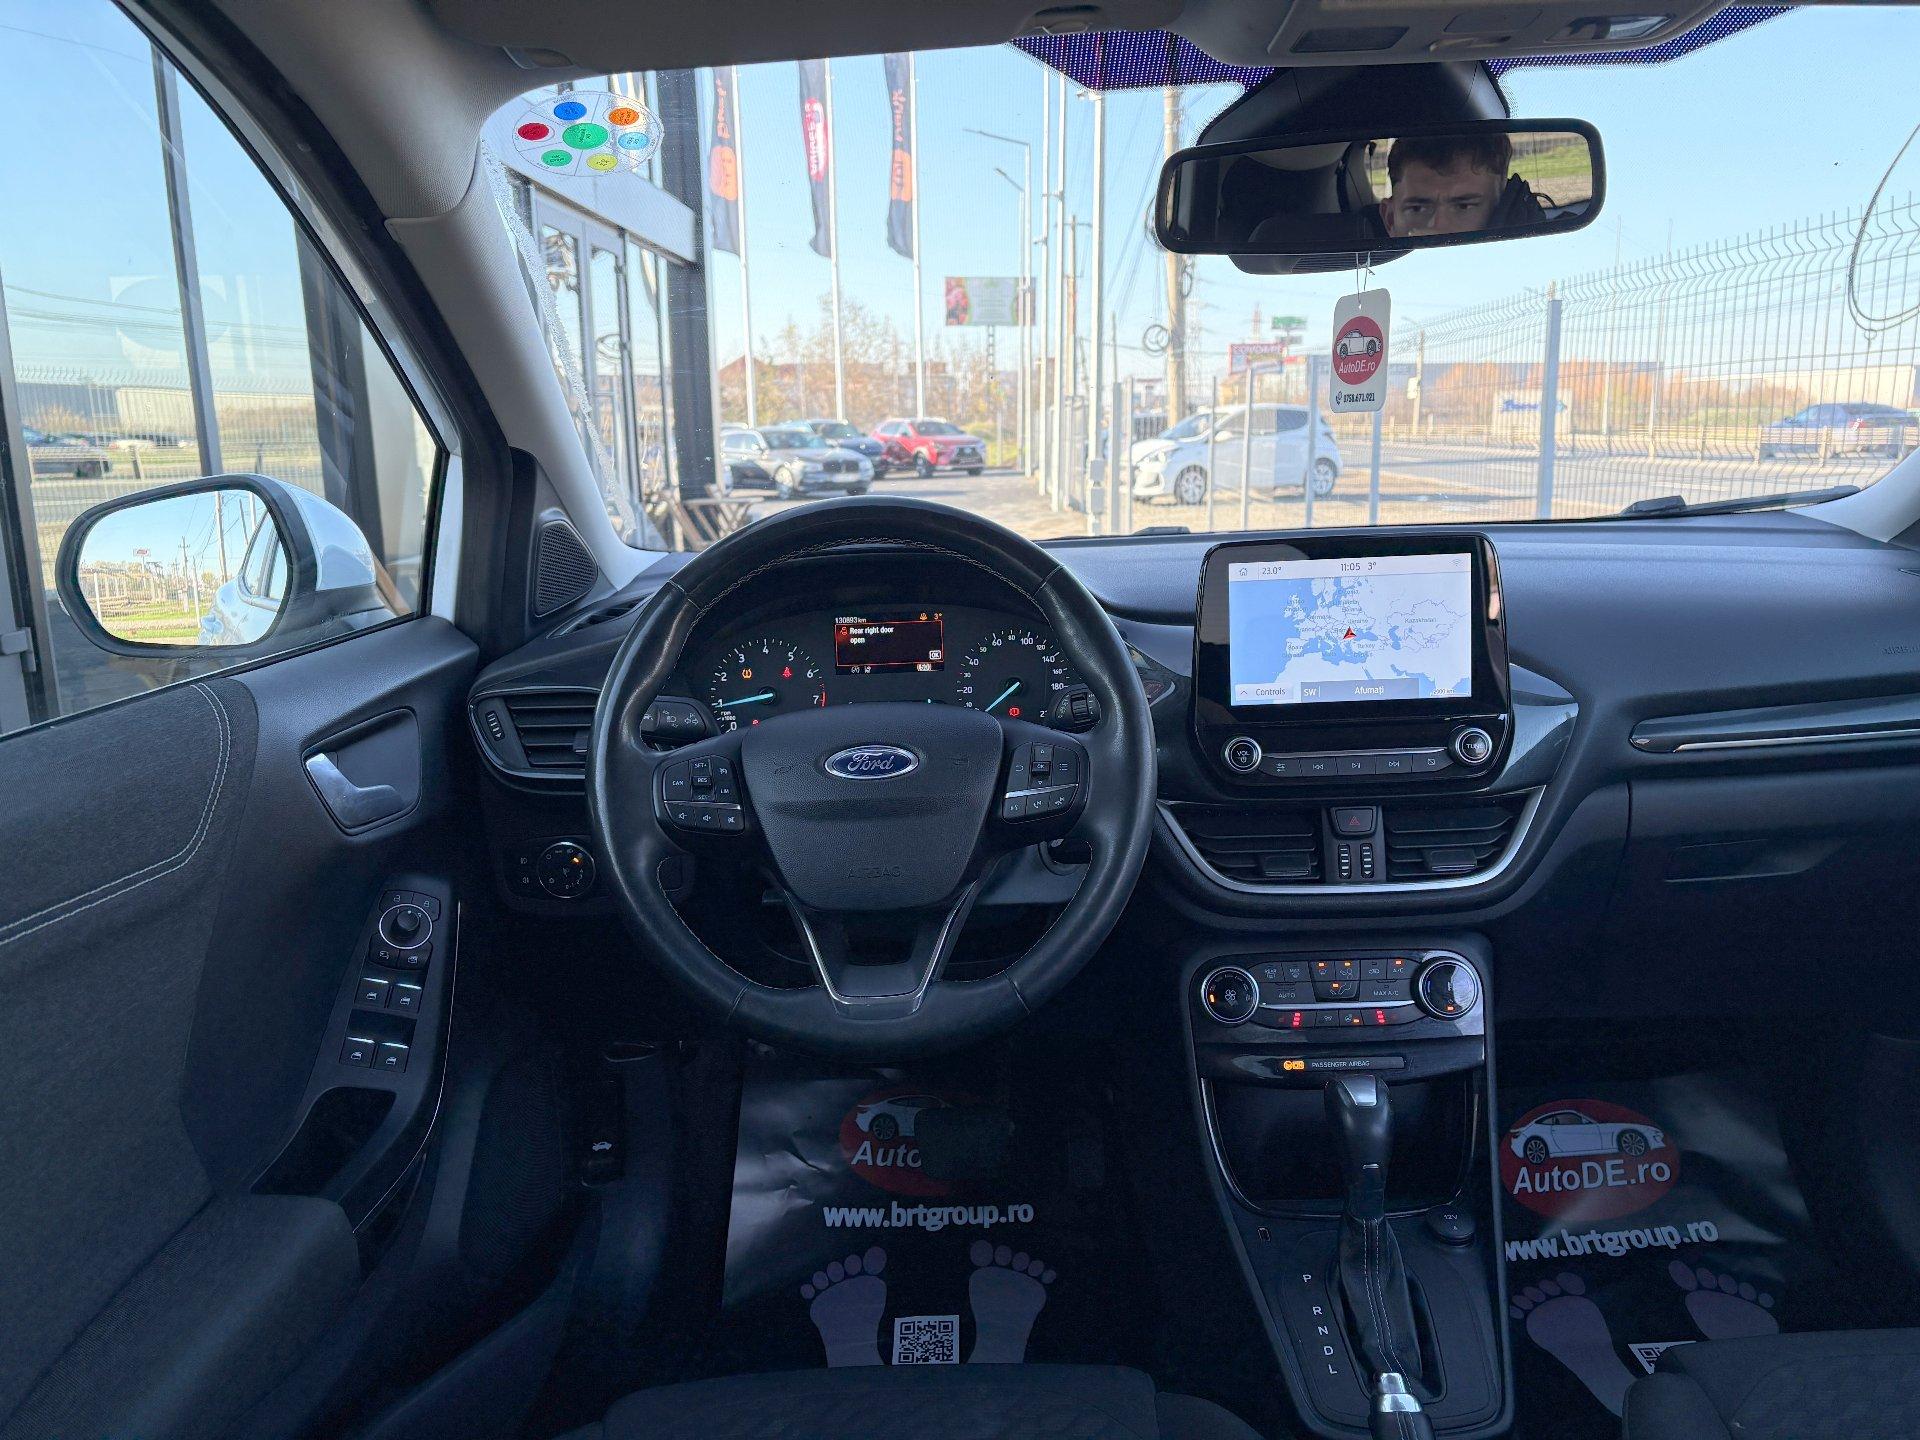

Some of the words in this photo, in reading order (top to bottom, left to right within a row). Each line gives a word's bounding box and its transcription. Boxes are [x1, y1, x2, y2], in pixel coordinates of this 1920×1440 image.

[1339, 360, 1376, 374] AutoDE.ro
[1341, 562, 1361, 571] 11:05
[849, 627, 864, 635] Rear
[865, 626, 880, 636] right
[880, 626, 894, 634] door
[850, 637, 866, 645] open
[992, 638, 1002, 647] 60
[1020, 637, 1034, 645] 100
[762, 645, 769, 655] 4
[738, 653, 745, 663] 3
[788, 652, 794, 661] 5
[1042, 655, 1056, 663] 140
[969, 658, 979, 666] 40
[720, 672, 727, 681] 2
[807, 669, 814, 678] 6
[963, 686, 973, 694] 20
[1255, 687, 1286, 696] Controls
[1303, 688, 1317, 697] SW
[812, 695, 819, 705] 7
[730, 721, 737, 731] 0
[847, 752, 895, 772] Ford
[1512, 1159, 1672, 1194] AutoDE.ro
[822, 1201, 1035, 1232] www.brtgroup.ro
[1504, 1220, 1720, 1263] www.brtgroup.ro
[1302, 1273, 1312, 1283] P
[1312, 1306, 1323, 1316] R
[1318, 1326, 1329, 1336] N
[1323, 1345, 1334, 1356] D
[1328, 1363, 1338, 1375] L
